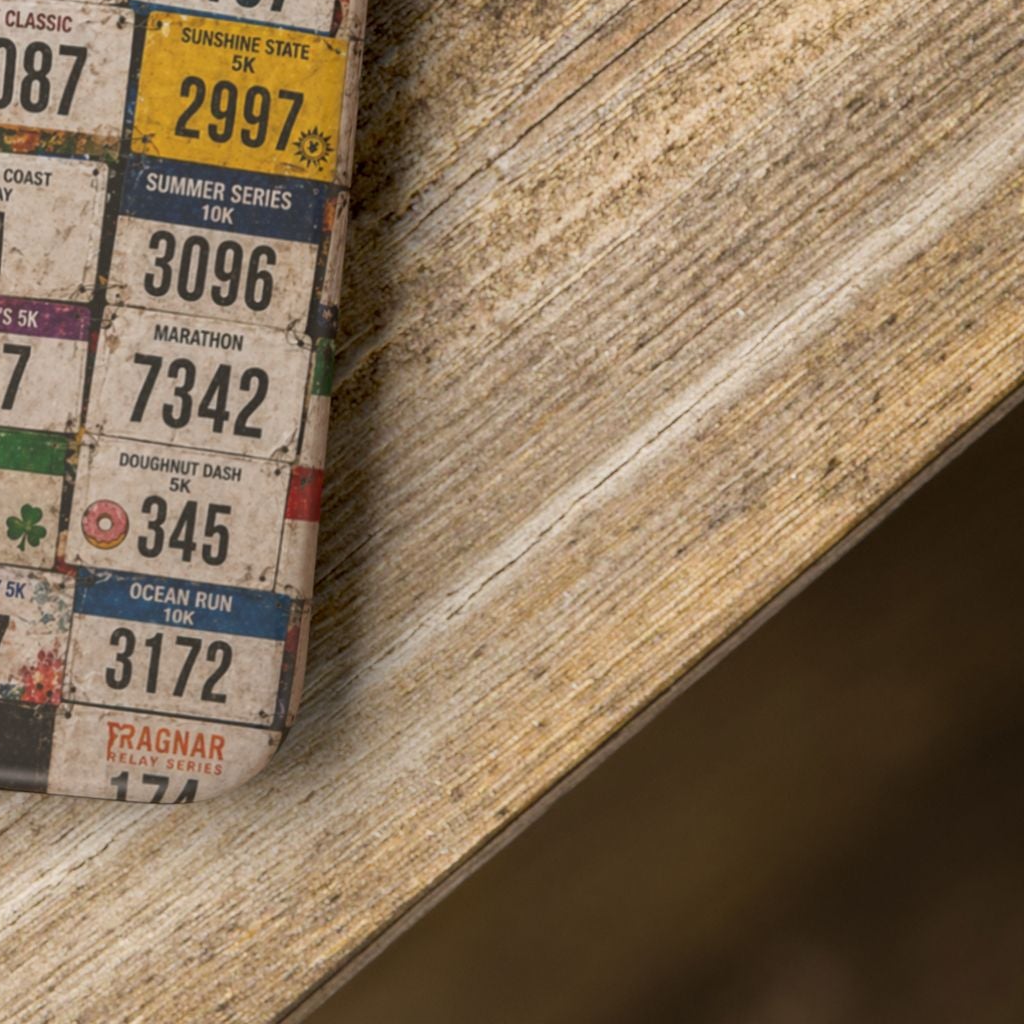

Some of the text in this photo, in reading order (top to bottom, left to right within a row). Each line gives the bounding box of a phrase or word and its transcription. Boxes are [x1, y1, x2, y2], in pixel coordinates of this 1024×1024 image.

[5, 9, 74, 33] CLASSIC
[181, 27, 311, 61] SUNSHINE STATE
[231, 54, 256, 74] 5K
[174, 76, 304, 152] 2997
[2, 168, 53, 187] COAST
[146, 172, 293, 211] SUMMER SERIES
[201, 204, 234, 225] 10K
[143, 230, 277, 312] 3096
[17, 309, 39, 329] 5K
[153, 323, 244, 352] MARATHON
[129, 352, 270, 440] 7342
[119, 452, 242, 483] DOUGHNUT DASH
[168, 477, 191, 494] 5K
[136, 494, 232, 566] 345
[5, 580, 27, 600] 5K
[129, 582, 233, 613] OCEAN RUN
[163, 607, 195, 626] 10K
[105, 626, 233, 704] 3172
[107, 720, 226, 761] RAGNAR
[107, 751, 224, 777] RELAY SERIES
